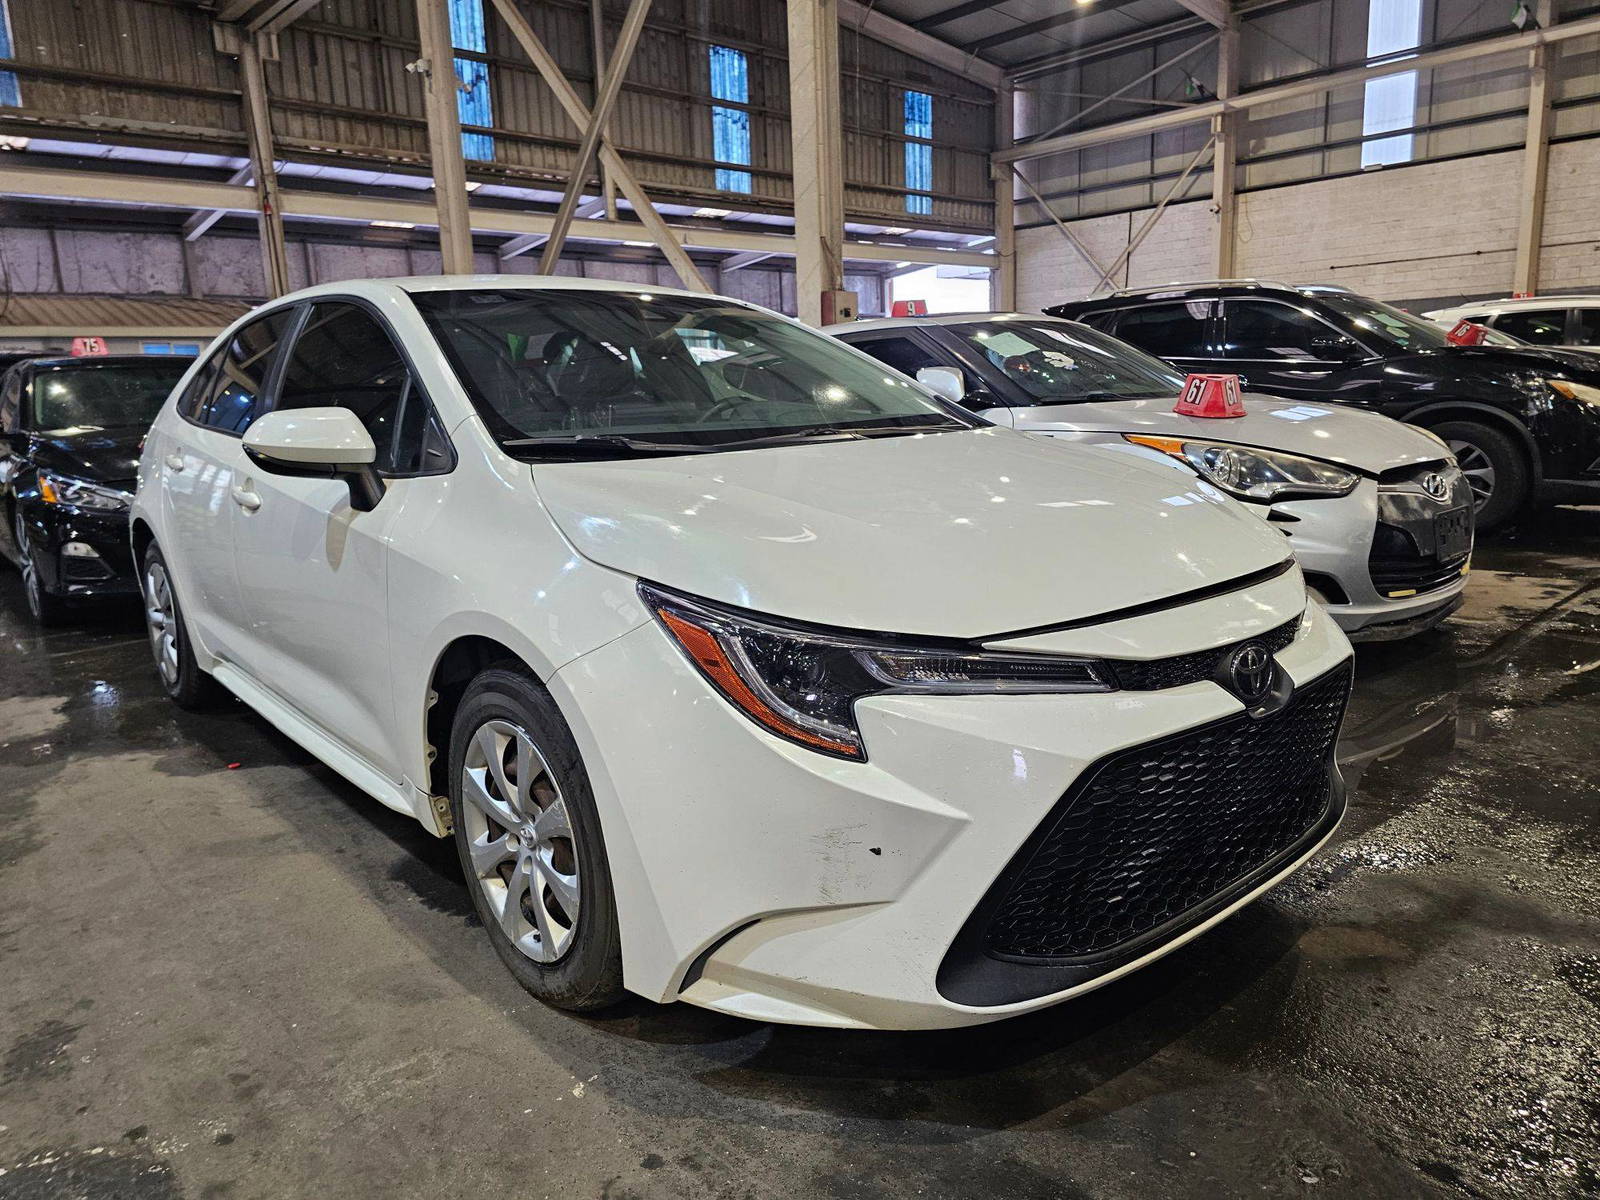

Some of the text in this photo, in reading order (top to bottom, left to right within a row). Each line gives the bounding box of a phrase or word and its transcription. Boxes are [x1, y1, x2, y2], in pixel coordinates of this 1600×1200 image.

[907, 301, 916, 317] 9
[82, 338, 100, 353] 75
[1185, 378, 1208, 405] 61
[1225, 378, 1238, 406] 61
